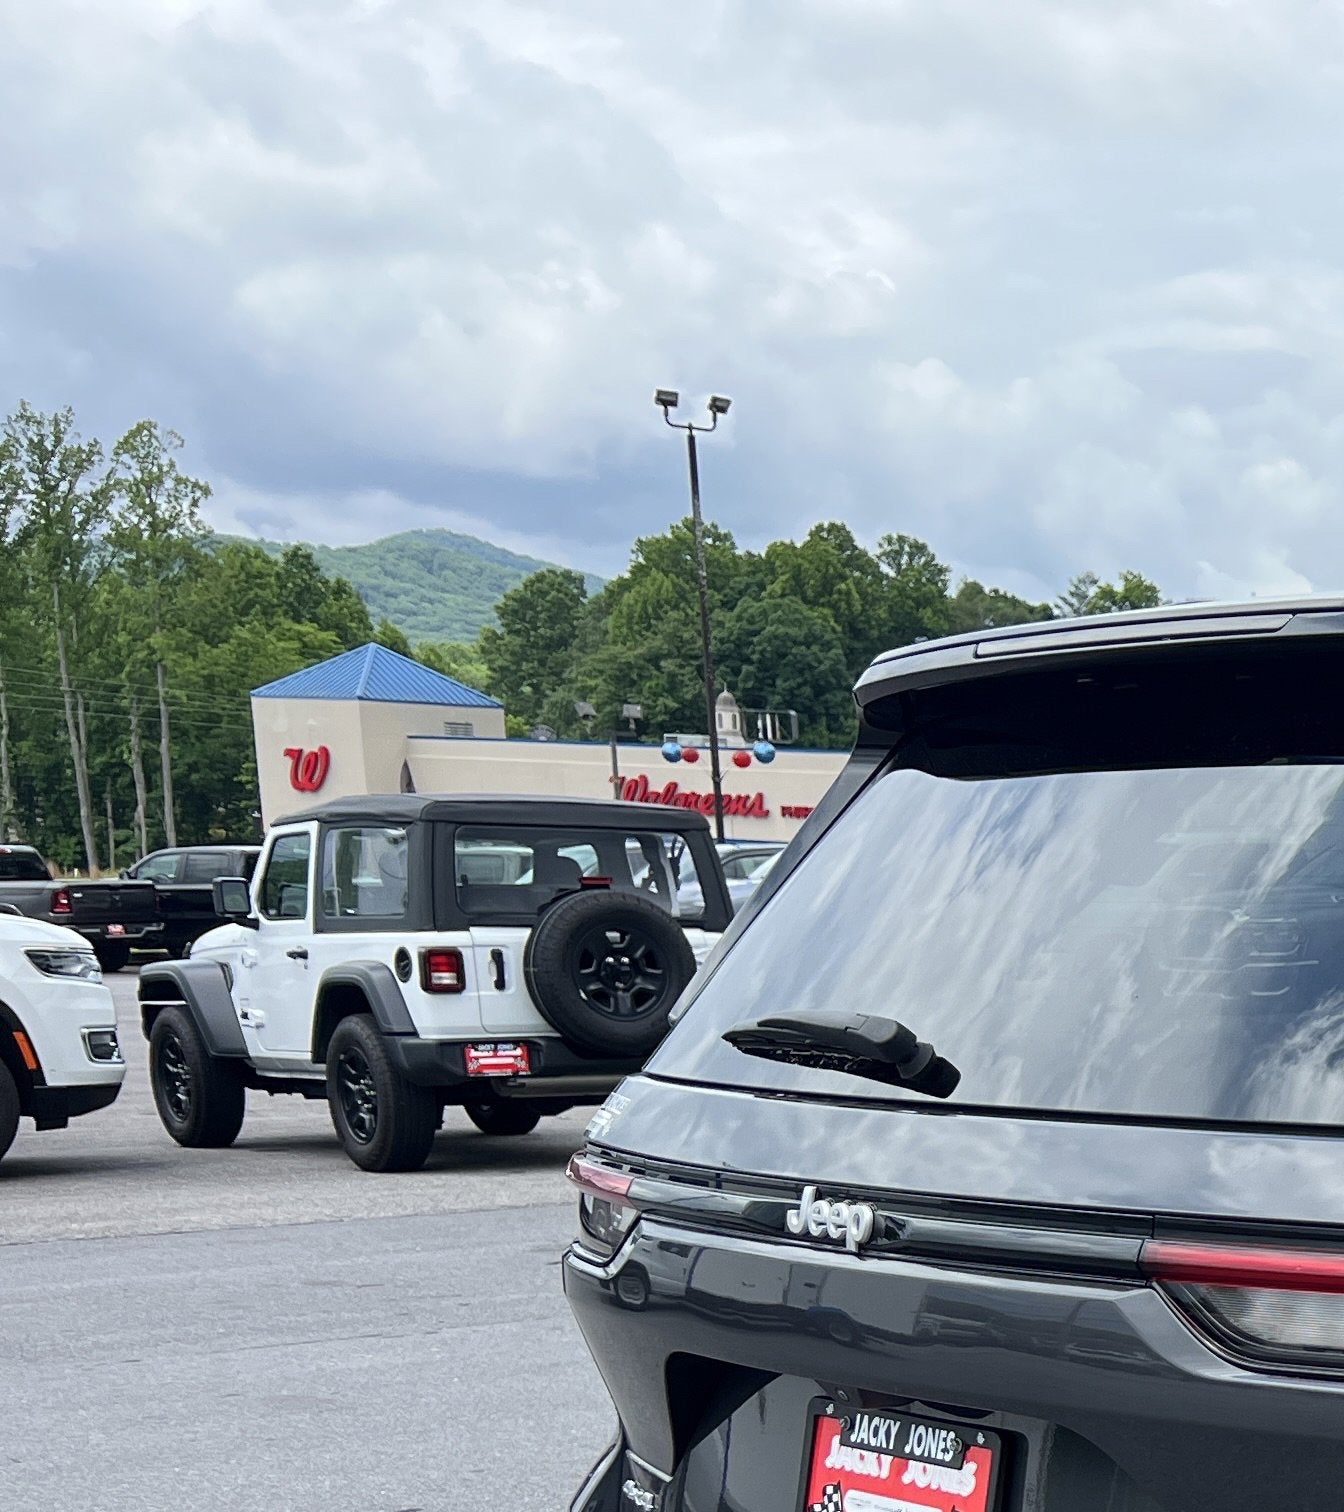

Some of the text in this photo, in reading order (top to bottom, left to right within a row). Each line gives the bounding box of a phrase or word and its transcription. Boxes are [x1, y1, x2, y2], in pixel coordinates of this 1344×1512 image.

[283, 745, 331, 793] W
[786, 1185, 874, 1252] Jeep
[850, 1413, 956, 1462] JACKY JONES
